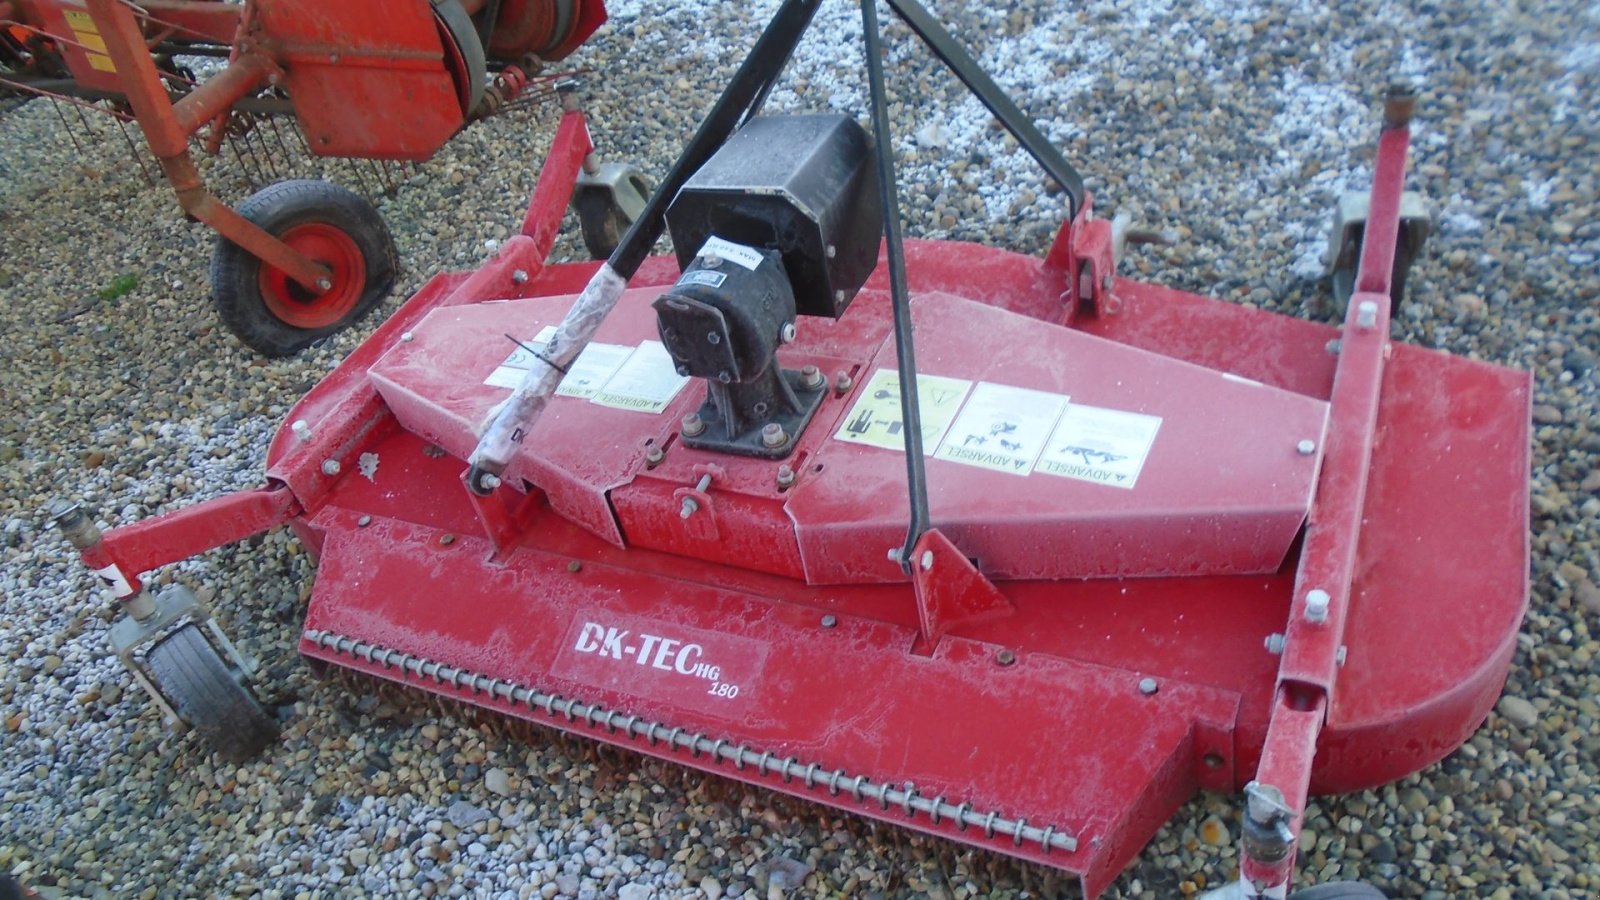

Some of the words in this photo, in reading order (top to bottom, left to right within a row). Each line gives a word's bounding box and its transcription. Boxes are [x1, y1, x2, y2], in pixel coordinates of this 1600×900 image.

[602, 391, 651, 408] ADVARSEL
[948, 446, 1011, 466] ADVARSEL
[1047, 460, 1112, 480] ADVARSEL
[708, 681, 739, 699] 180
